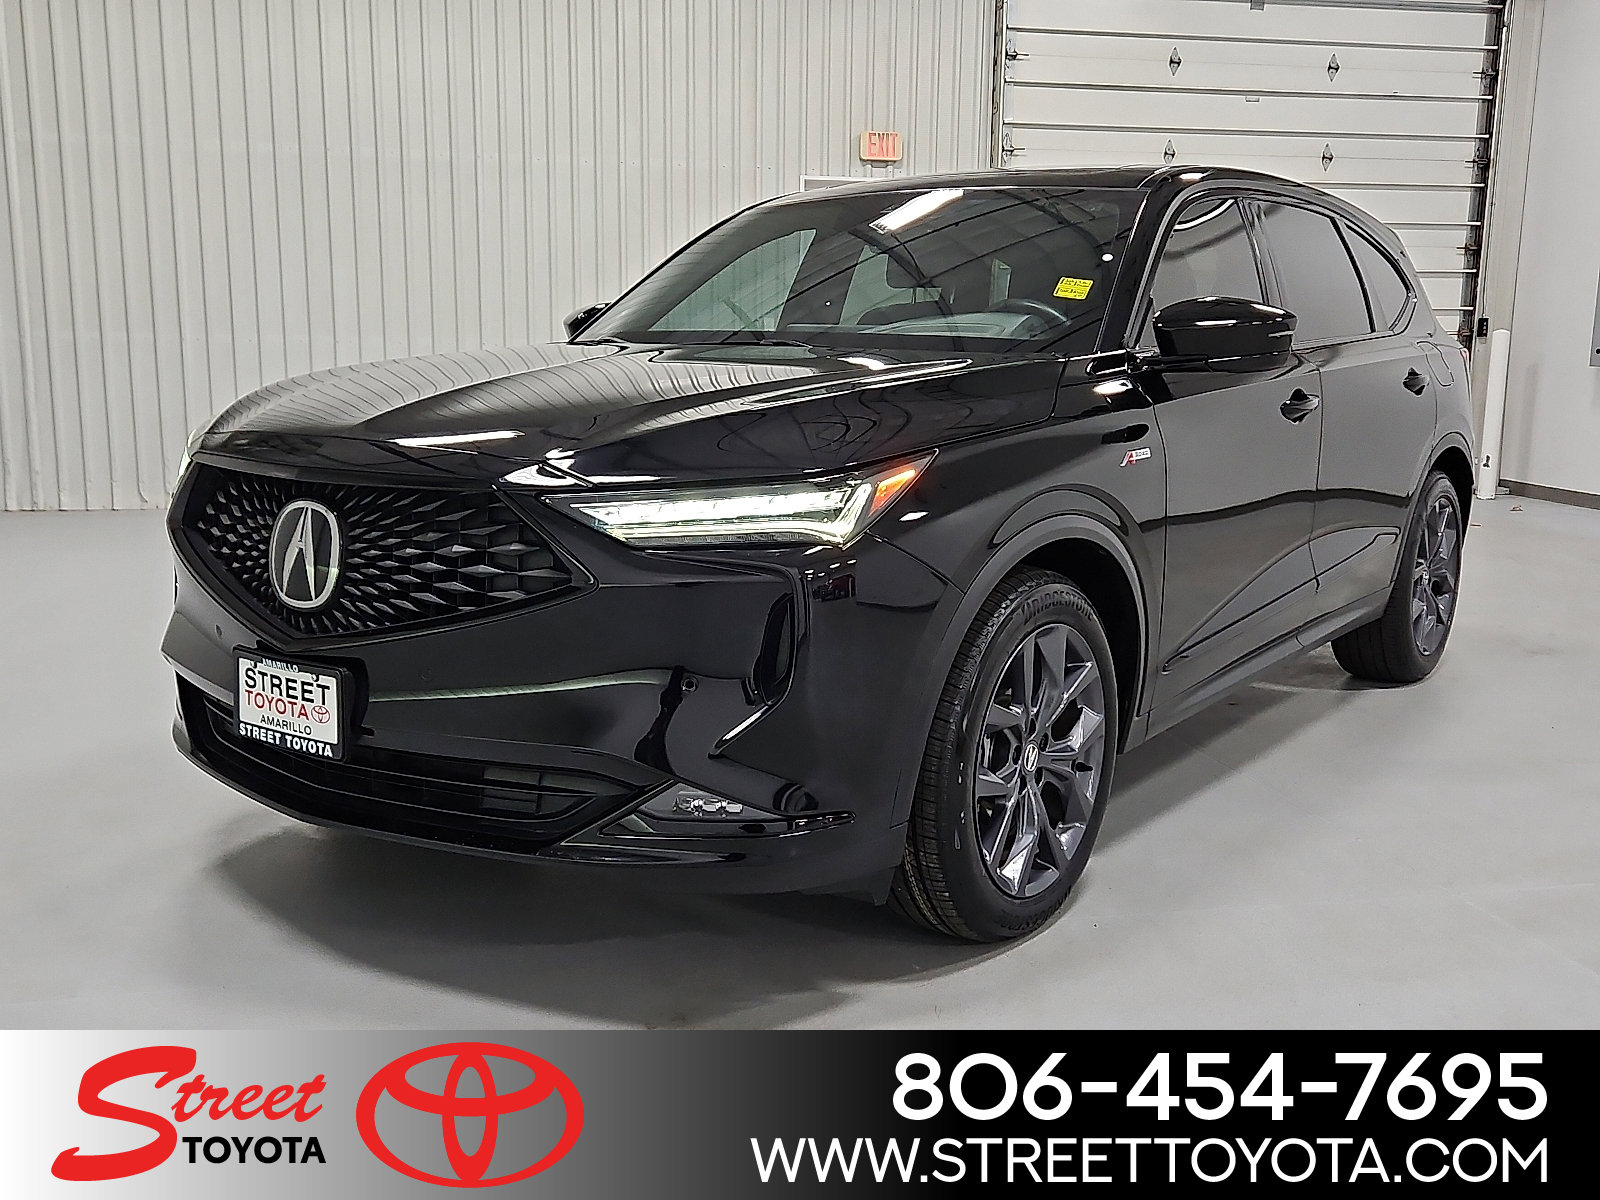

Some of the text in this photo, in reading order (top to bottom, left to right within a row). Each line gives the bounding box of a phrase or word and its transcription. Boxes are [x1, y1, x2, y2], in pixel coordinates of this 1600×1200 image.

[868, 132, 898, 158] EXIT
[262, 658, 299, 673] AMARILLO
[244, 668, 331, 705] STREET
[245, 689, 310, 721] TOYOTA
[239, 722, 333, 758] STREET TOYOTA
[260, 715, 312, 736] AMARILLO
